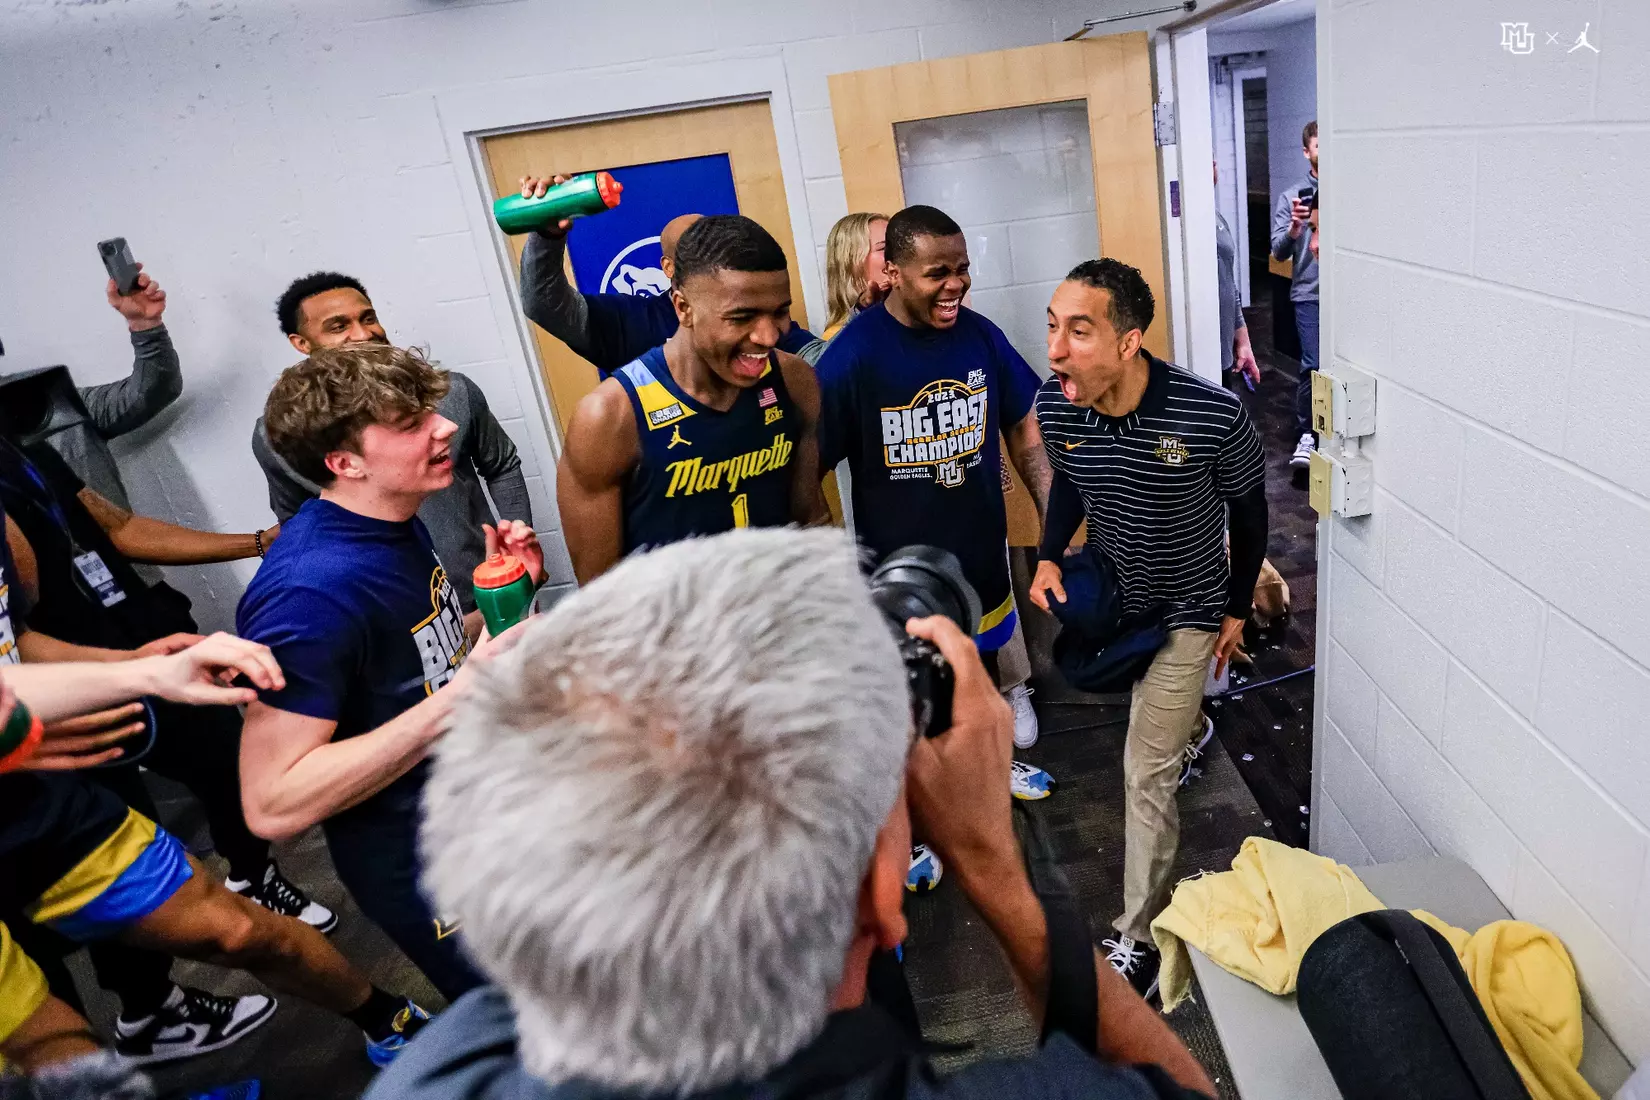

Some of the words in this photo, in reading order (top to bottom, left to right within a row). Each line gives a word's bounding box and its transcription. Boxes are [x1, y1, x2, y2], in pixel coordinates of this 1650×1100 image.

[968, 369, 983, 379] BIG
[928, 390, 957, 403] 2023
[881, 407, 934, 445] BIG
[937, 390, 987, 433] EAST
[665, 433, 793, 497] Marquette
[889, 473, 911, 481] GOLDEN
[891, 467, 928, 475] MARQUETTE
[937, 459, 964, 487] MU
[731, 493, 749, 528] 1
[413, 606, 465, 681] BIG
